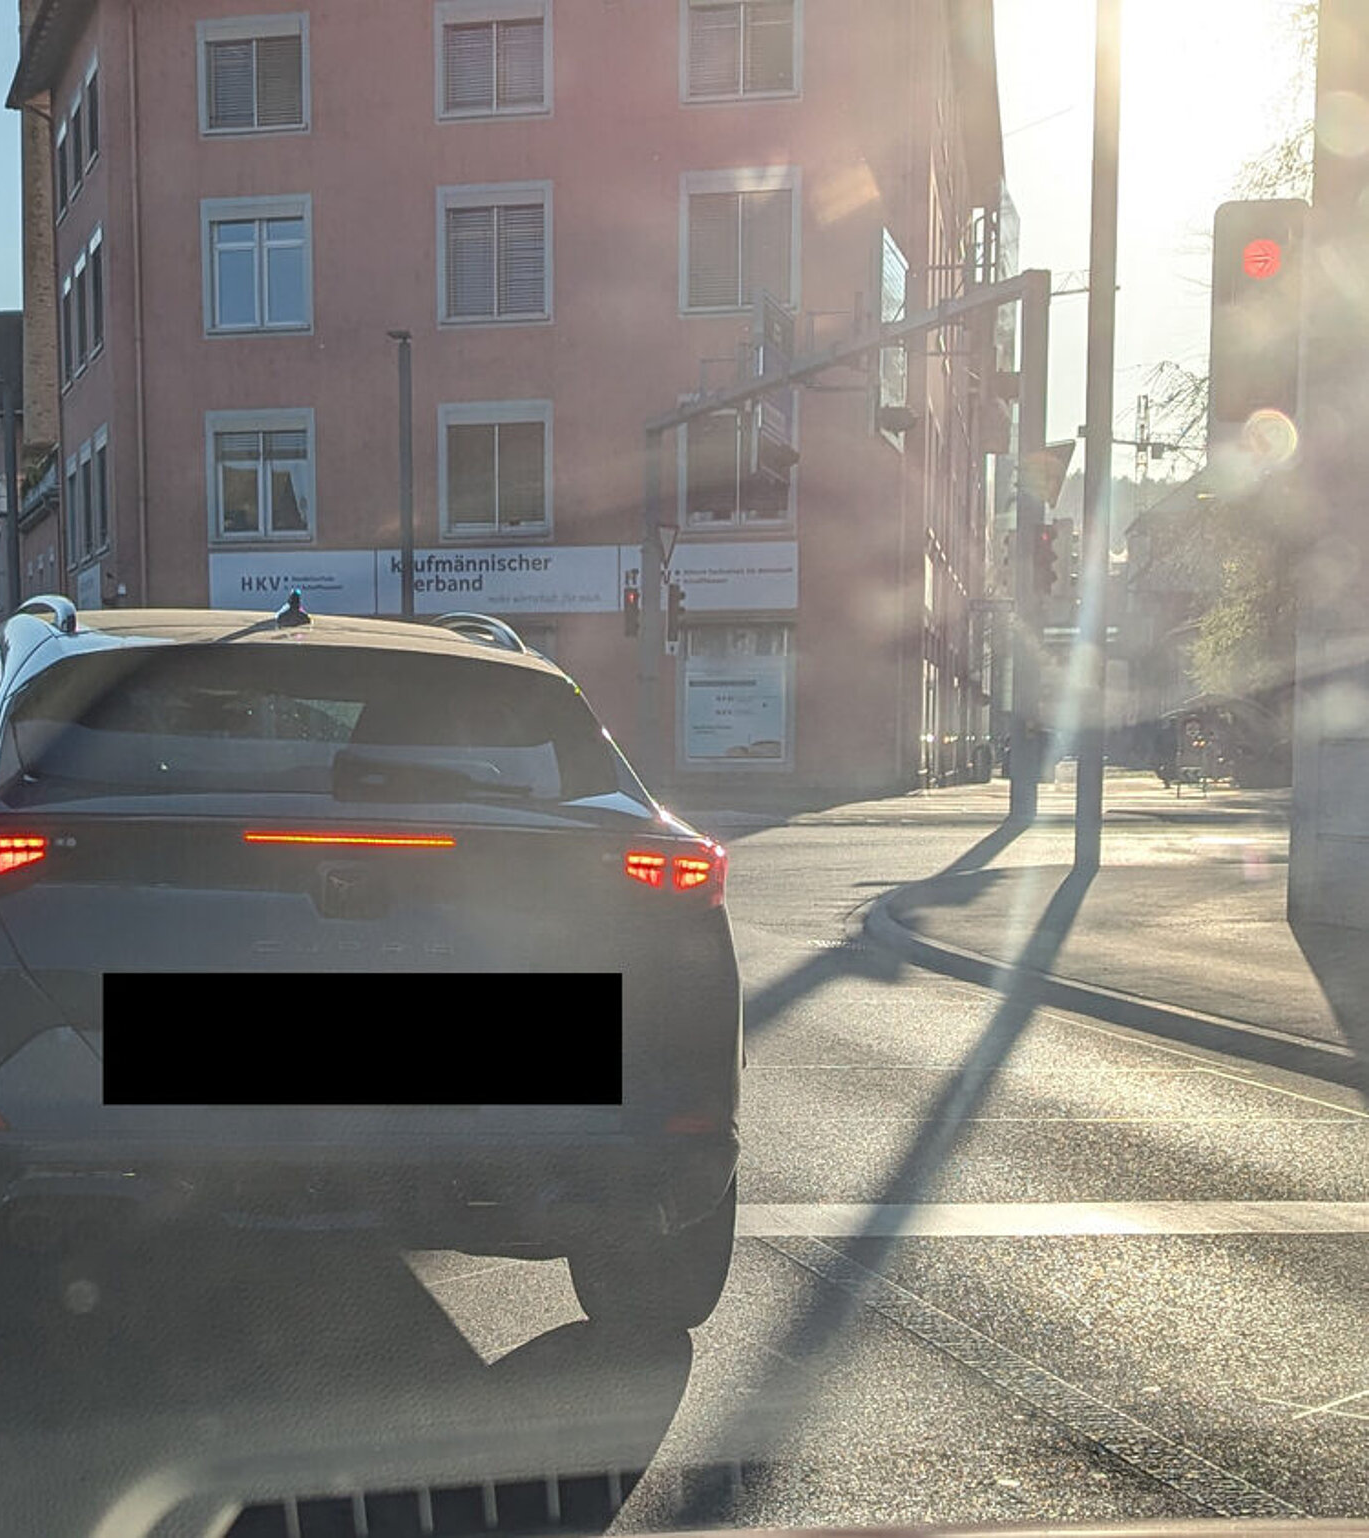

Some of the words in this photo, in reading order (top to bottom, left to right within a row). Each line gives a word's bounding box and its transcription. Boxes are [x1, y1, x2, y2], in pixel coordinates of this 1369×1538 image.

[391, 553, 552, 573] kufmännischer
[241, 576, 281, 592] HKV
[413, 574, 484, 593] erband
